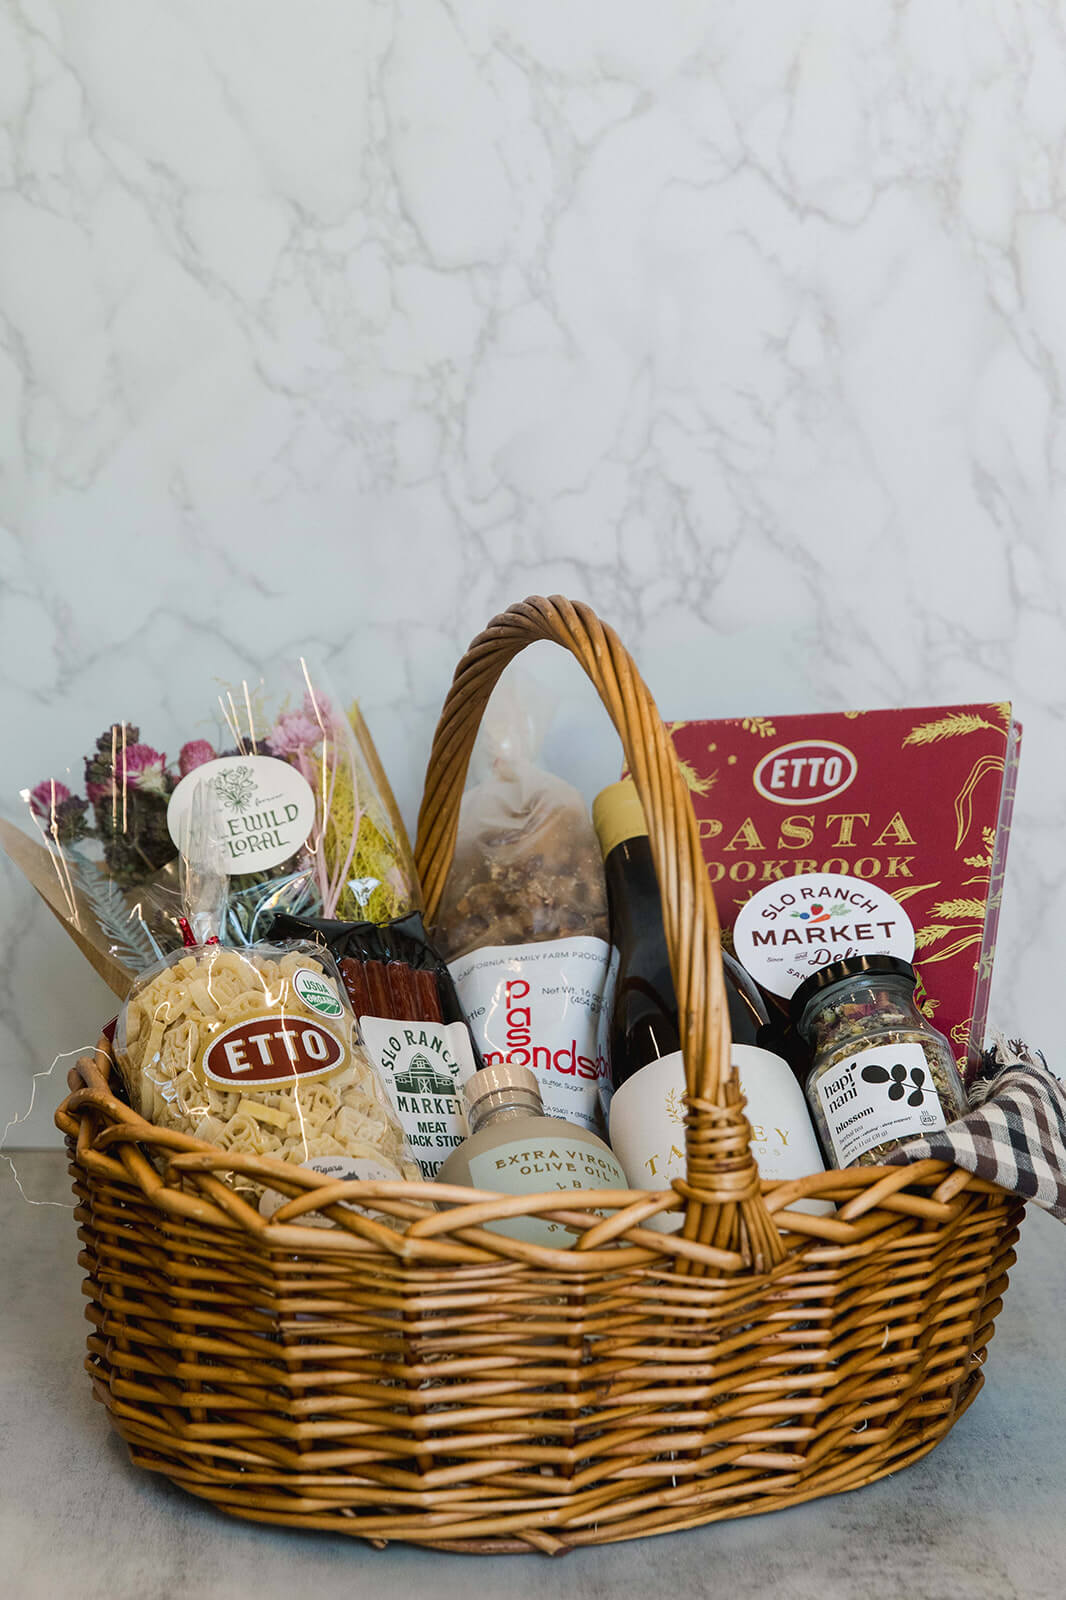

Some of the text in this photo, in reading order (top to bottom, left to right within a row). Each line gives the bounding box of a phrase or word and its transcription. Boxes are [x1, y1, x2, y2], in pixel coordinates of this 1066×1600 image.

[770, 757, 843, 789] ETTO
[227, 829, 291, 858] LORAL
[696, 811, 917, 851] PASTA
[706, 856, 916, 883] OOKBOOK
[761, 886, 879, 921] SLO RANCH
[752, 921, 897, 947] MARKET
[543, 951, 569, 961] FARM
[808, 946, 859, 966] Deli
[302, 979, 330, 995] USDA
[786, 968, 808, 981] SAN
[541, 986, 559, 996] Net
[581, 987, 592, 998] 16
[223, 1028, 328, 1074] ETTO
[381, 1029, 461, 1078] SLO RANCH
[824, 1068, 855, 1099] hapi
[396, 1095, 463, 1116] MARKET
[829, 1082, 858, 1114] nani
[417, 1121, 448, 1133] MEAT
[835, 1106, 874, 1135] blossom
[406, 1133, 434, 1147] NACK
[644, 1125, 791, 1177] TAEY
[495, 1150, 621, 1179] EXTRA VIRGIN
[519, 1162, 611, 1183] OLIVE OIL
